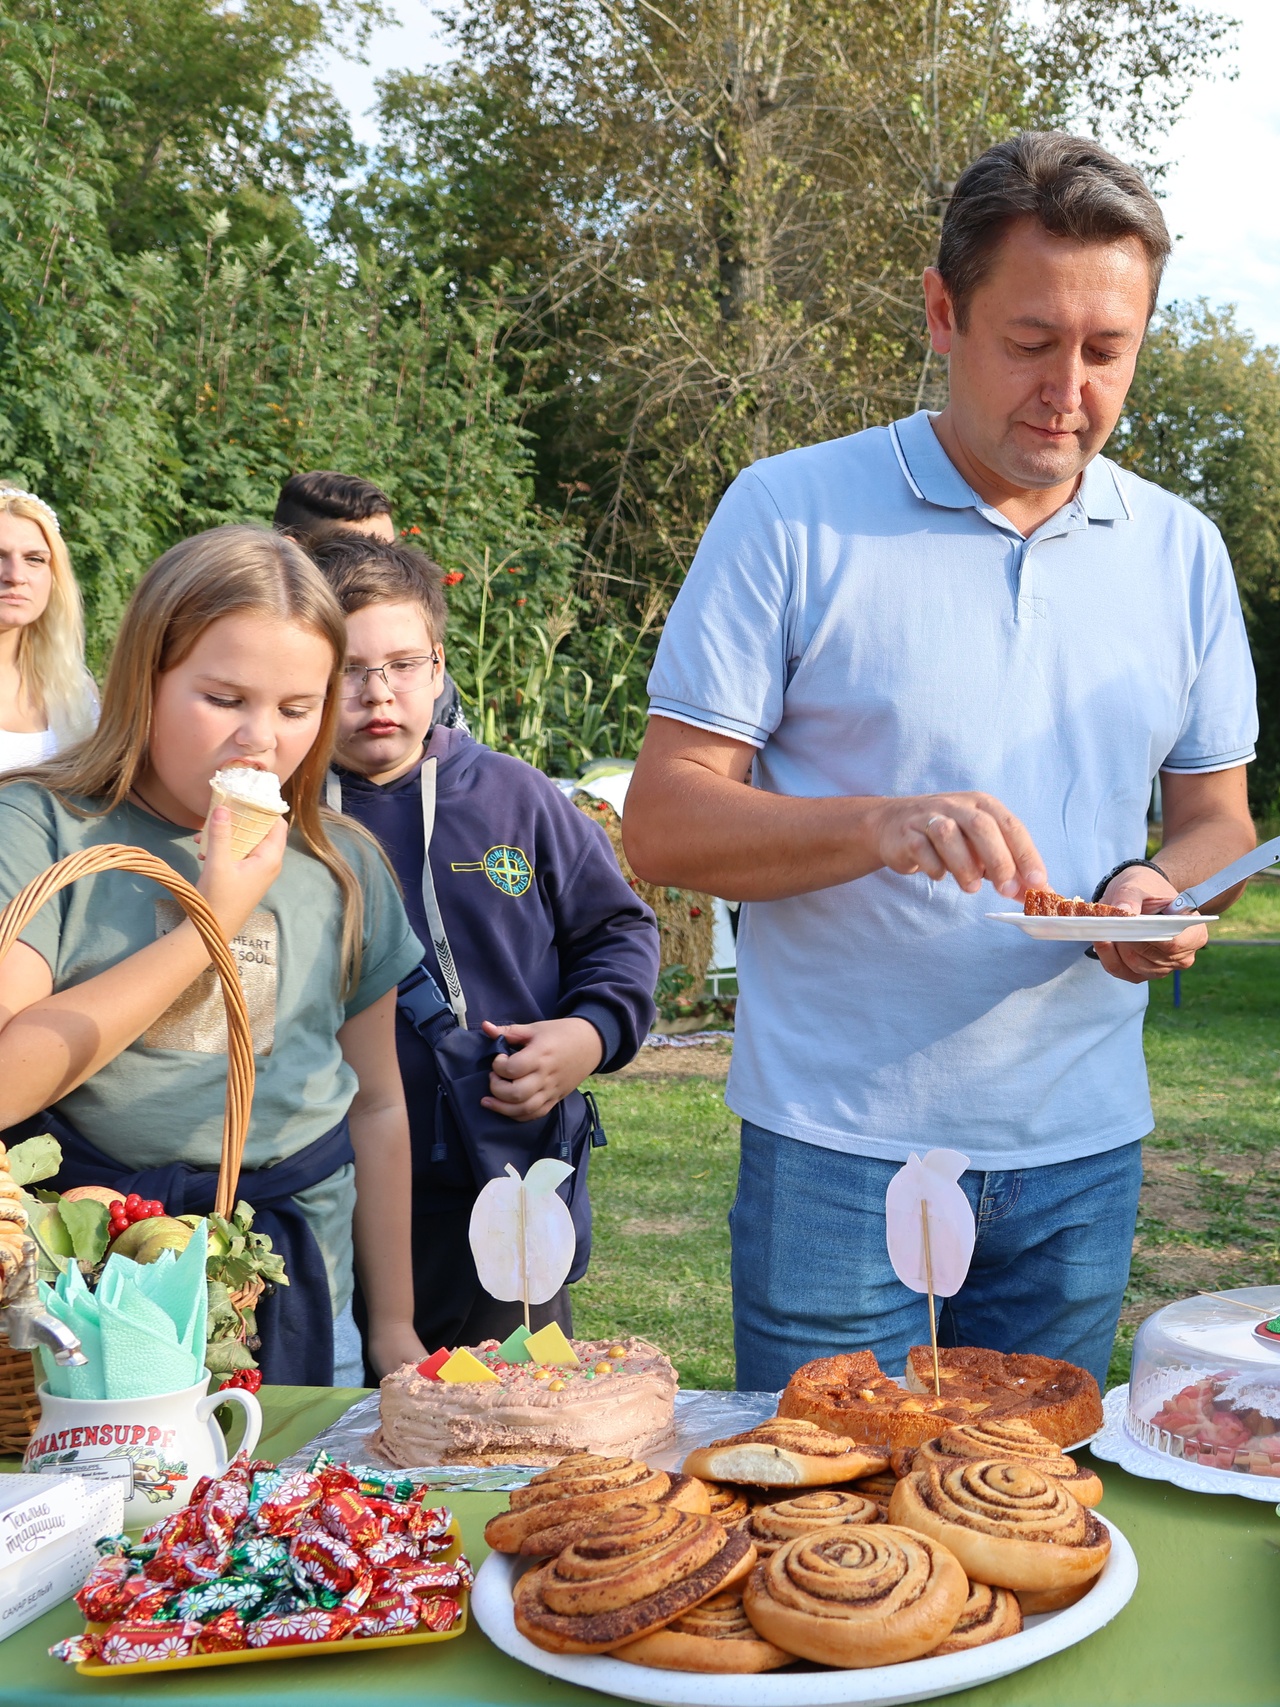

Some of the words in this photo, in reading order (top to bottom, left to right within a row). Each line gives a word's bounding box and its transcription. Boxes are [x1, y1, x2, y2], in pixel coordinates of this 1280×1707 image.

[487, 850, 504, 867] STONE
[511, 850, 528, 872] ISLAND
[233, 935, 271, 951] HEART
[239, 951, 272, 965] SOUL
[24, 1424, 177, 1466] TOMATENSUPPE
[2, 1503, 51, 1530] Теплые
[6, 1516, 66, 1554] традиции
